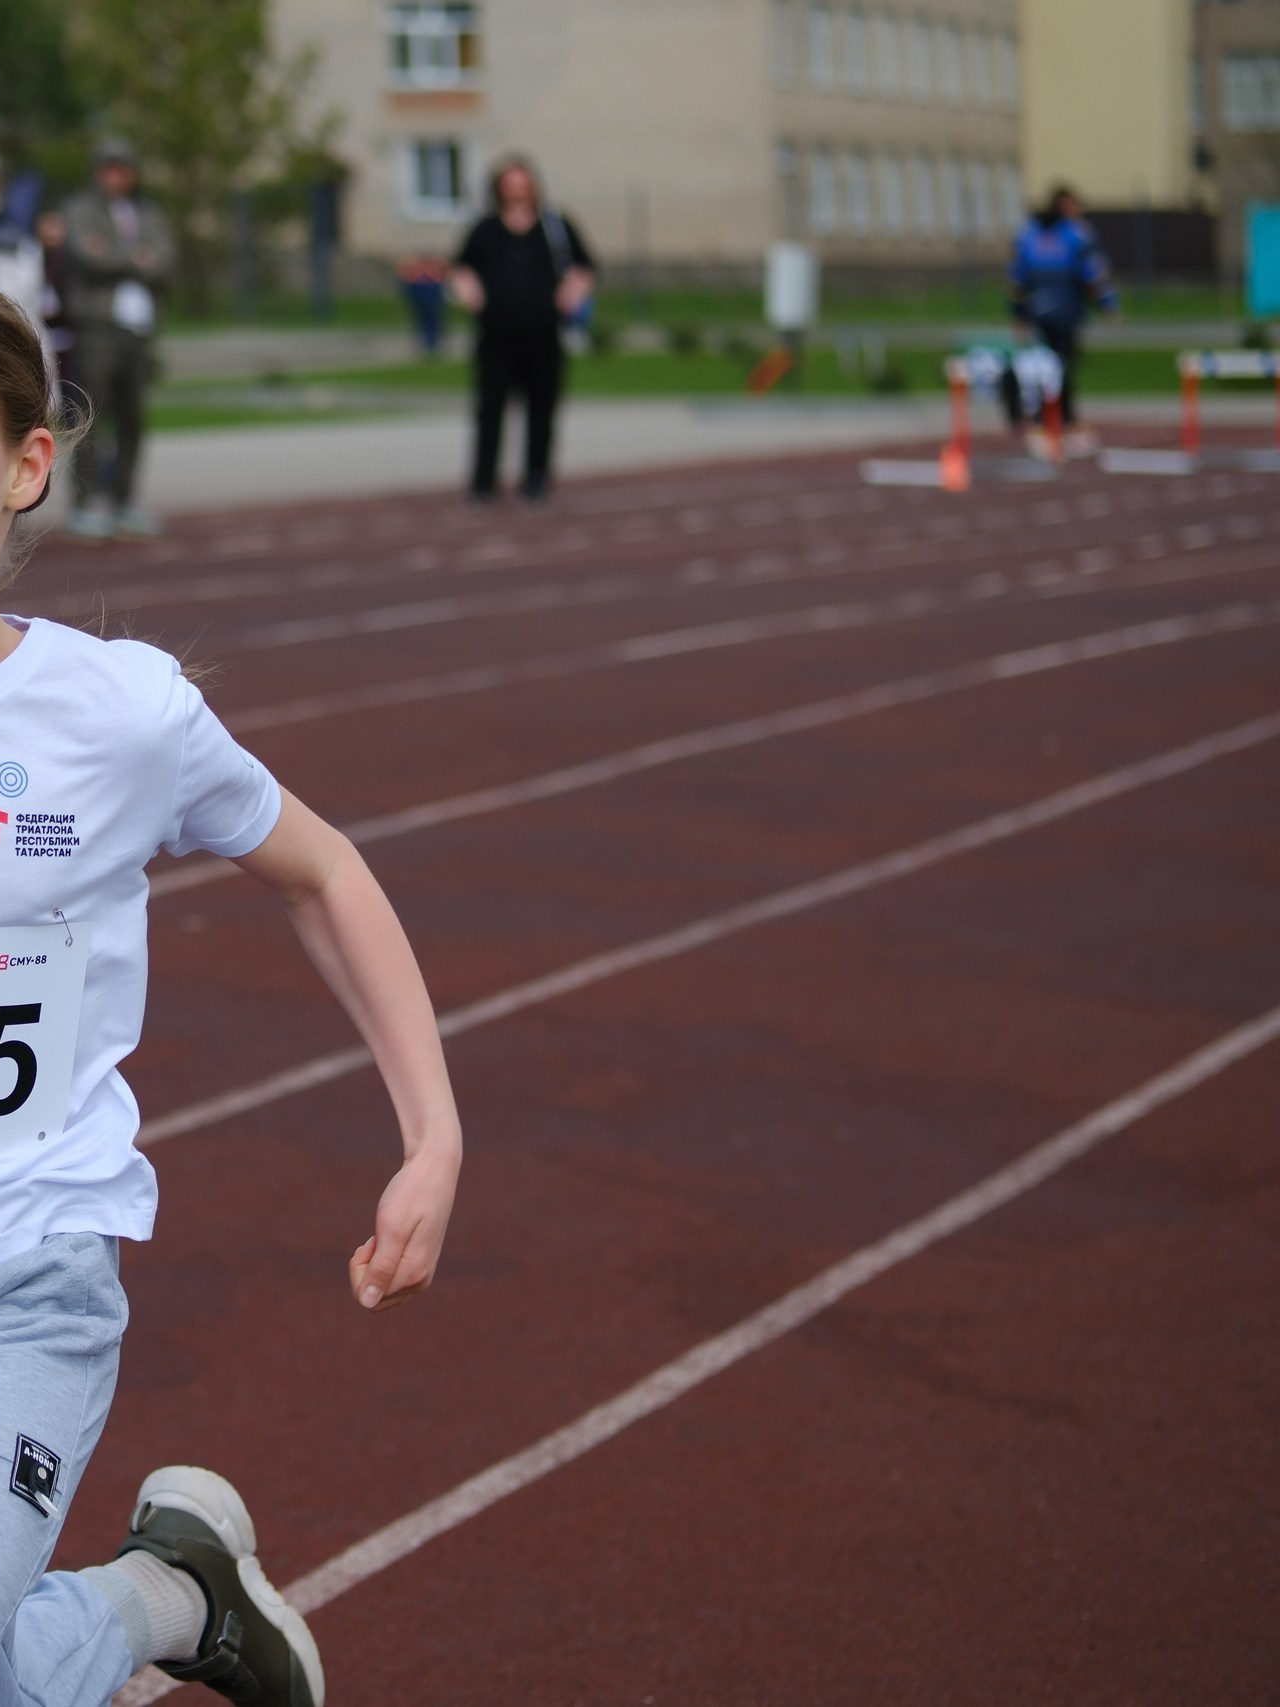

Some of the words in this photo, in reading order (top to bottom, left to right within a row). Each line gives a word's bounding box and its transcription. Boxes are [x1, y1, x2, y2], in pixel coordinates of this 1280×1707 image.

[16, 813, 75, 824] ФЕДЕРАЦИЯ
[15, 825, 73, 835] ТРИАТЛОНА
[15, 836, 80, 846] РЕСПУБЛИКИ
[15, 847, 72, 857] ТАТАРСТАН
[9, 954, 47, 967] СМУ-88
